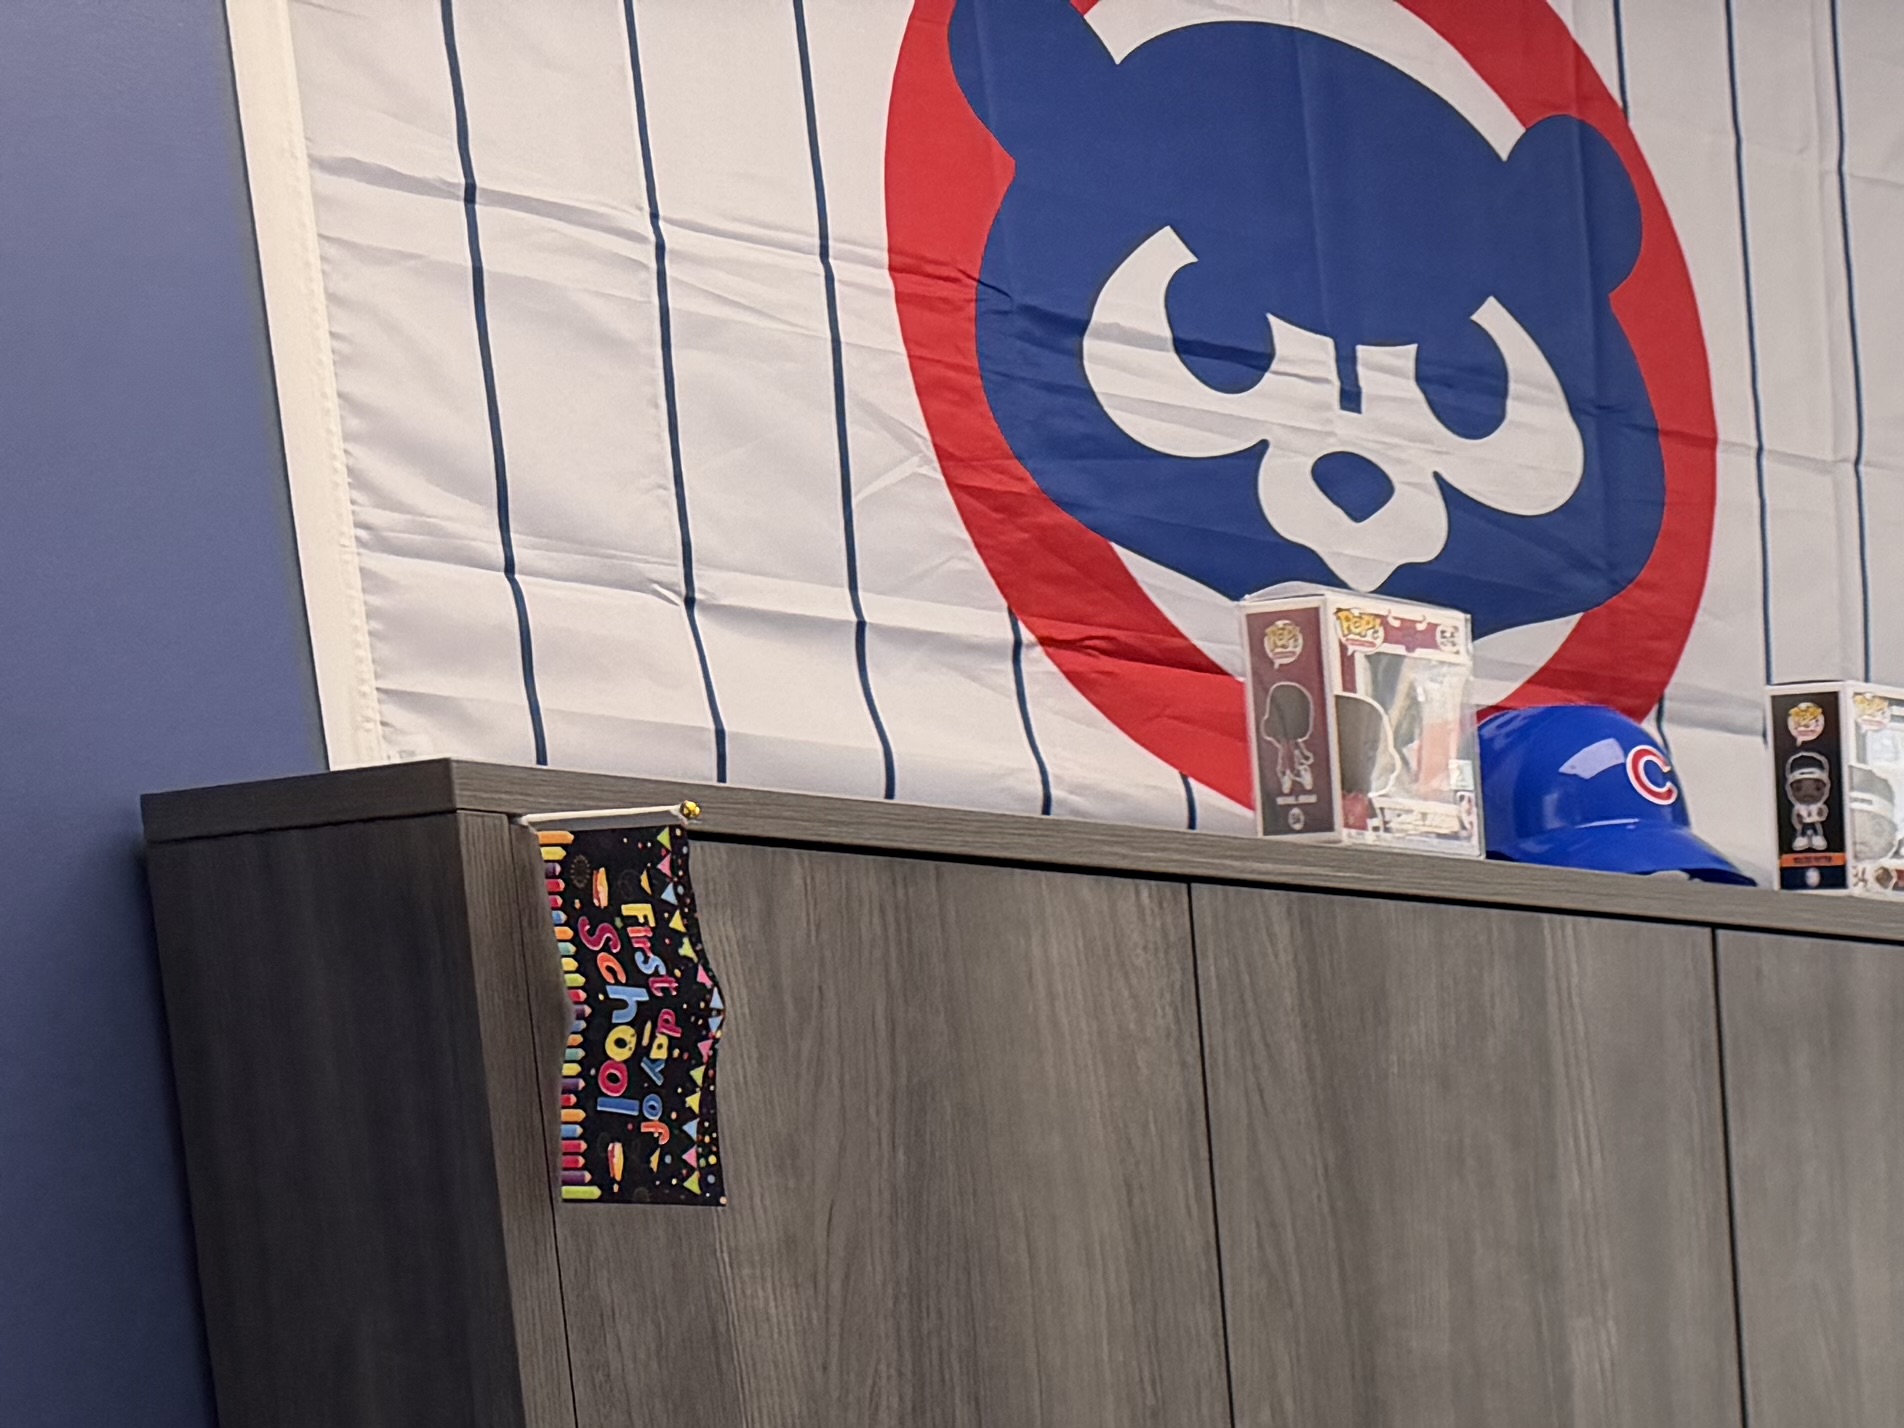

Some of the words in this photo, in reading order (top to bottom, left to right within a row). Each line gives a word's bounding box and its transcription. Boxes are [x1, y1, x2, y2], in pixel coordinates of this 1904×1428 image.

[1626, 744, 1677, 805] C
[621, 903, 679, 997] First
[578, 915, 650, 1116] School
[641, 1008, 681, 1085] day
[640, 1093, 670, 1144] of
